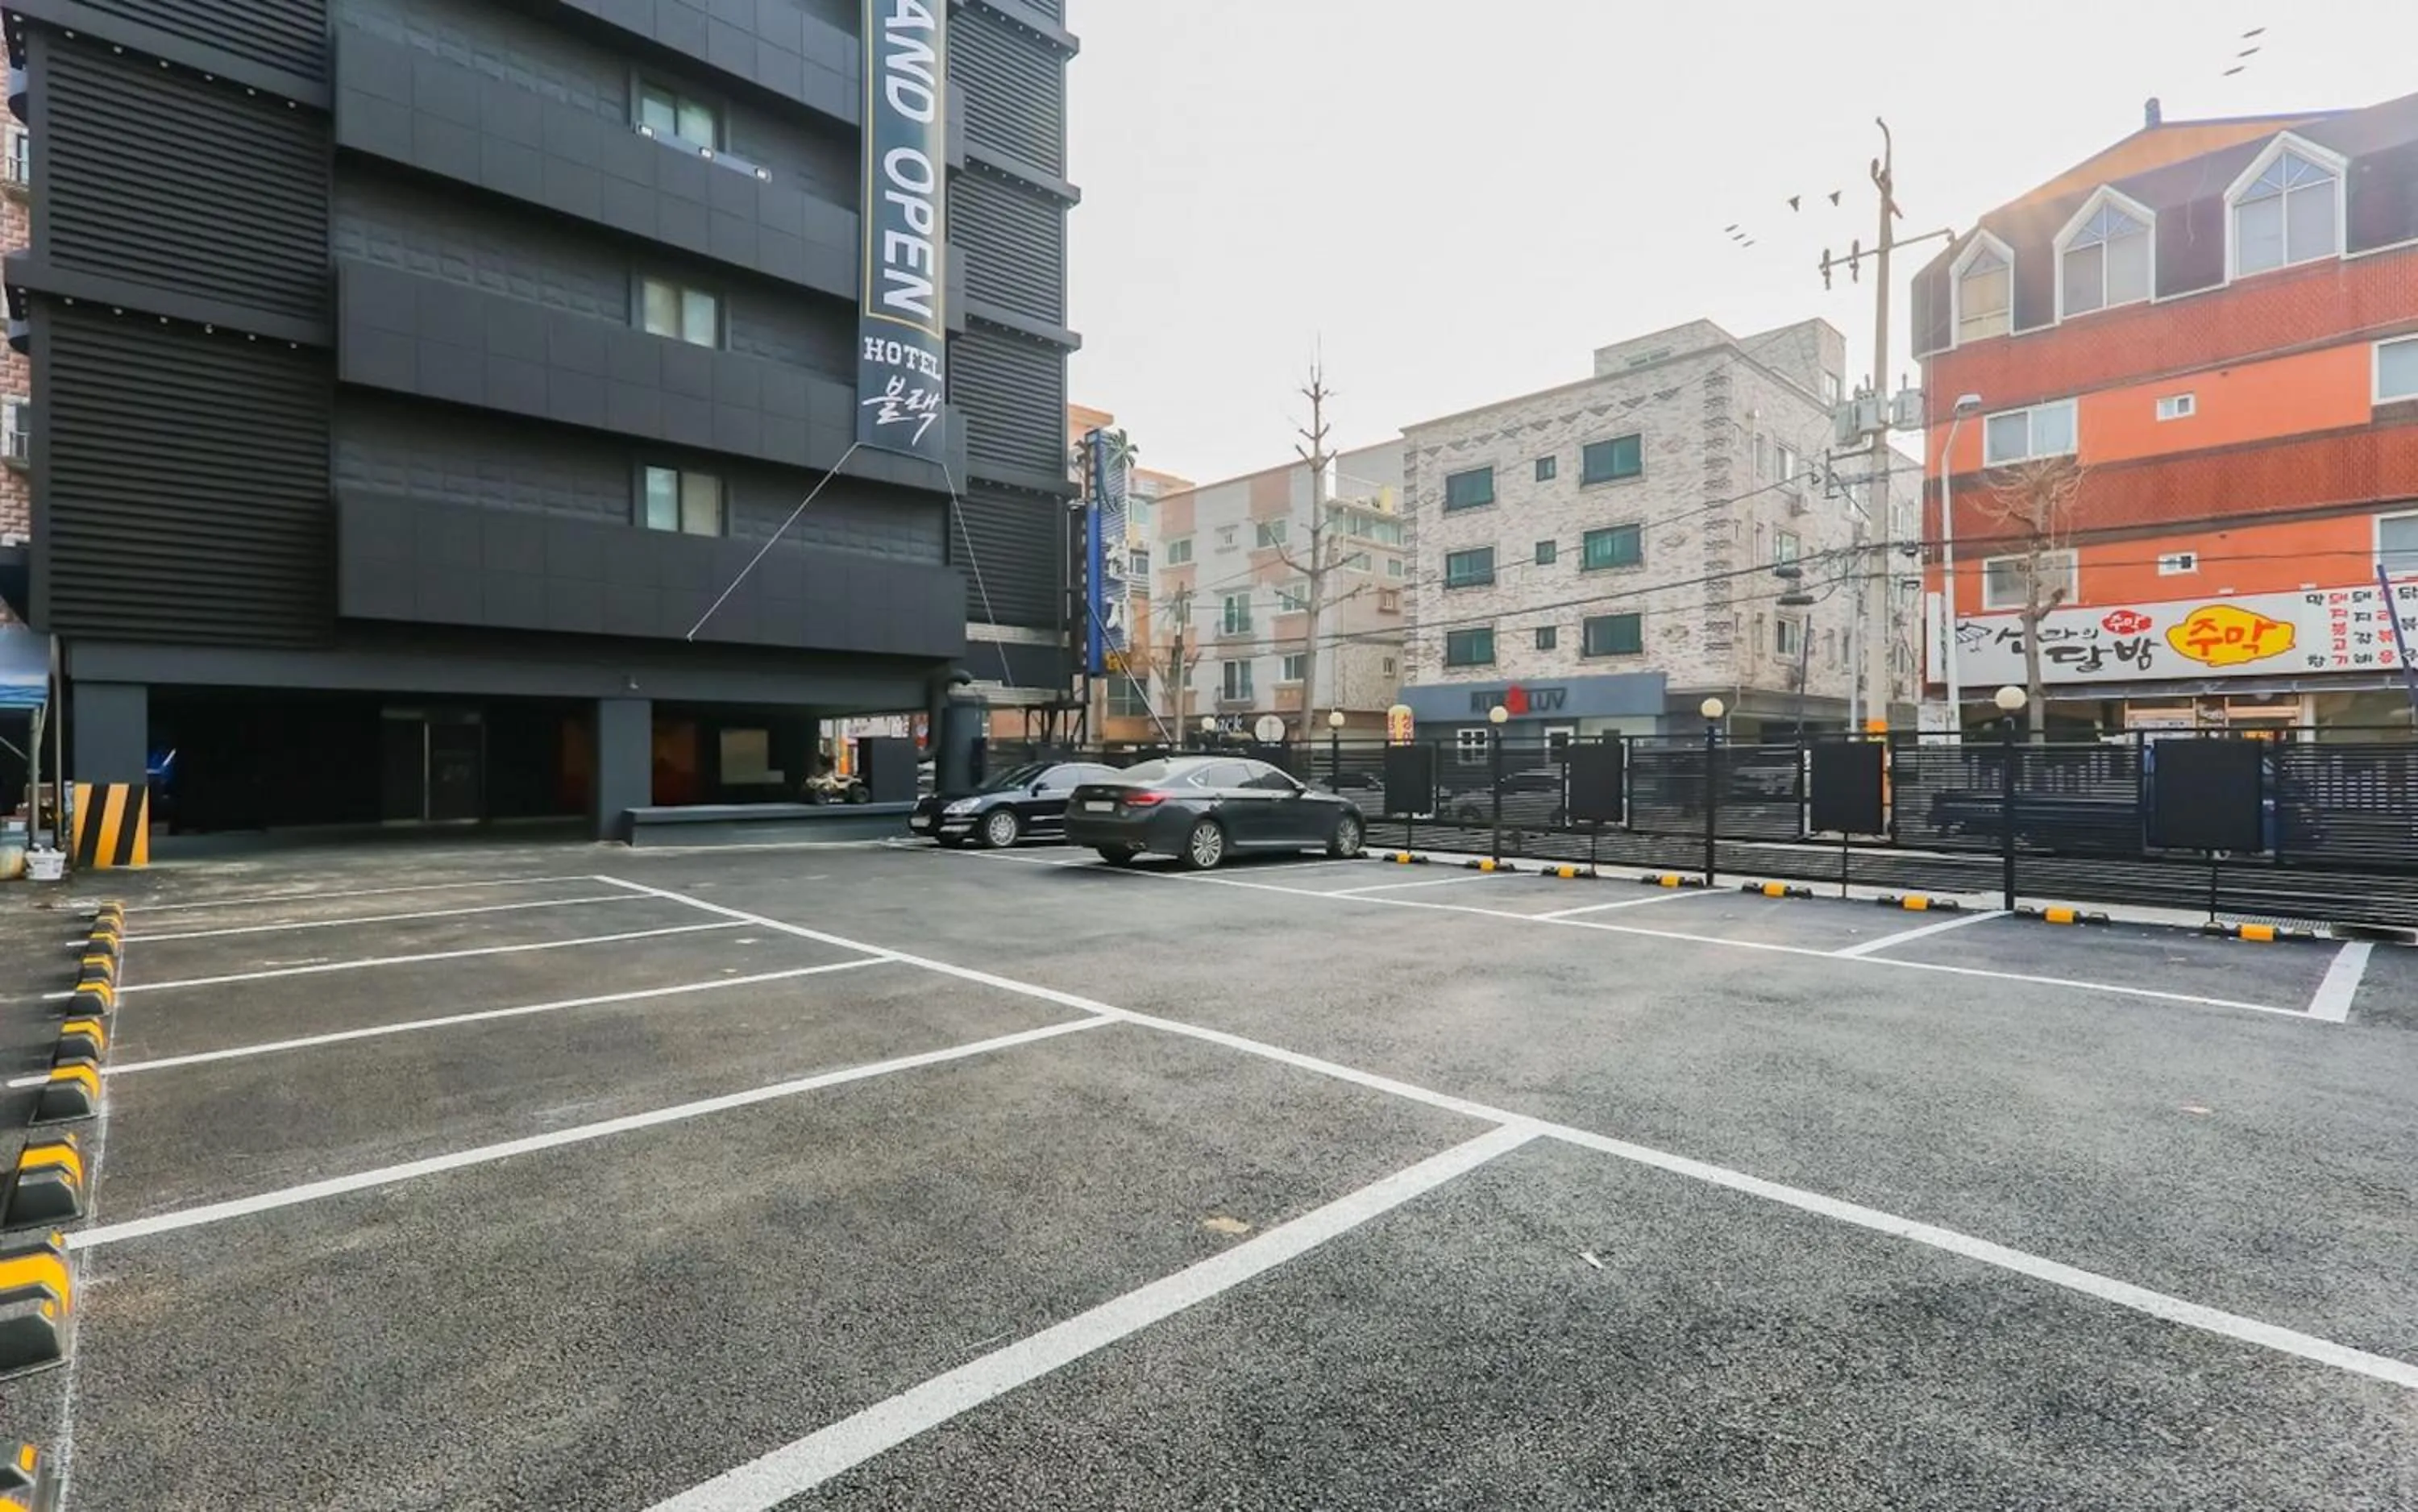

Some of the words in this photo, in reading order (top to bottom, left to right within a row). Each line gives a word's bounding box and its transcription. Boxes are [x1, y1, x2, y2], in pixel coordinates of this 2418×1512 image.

[883, 147, 935, 318] OPEN
[863, 336, 942, 381] HOTEL
[2186, 618, 2278, 657] 주막
